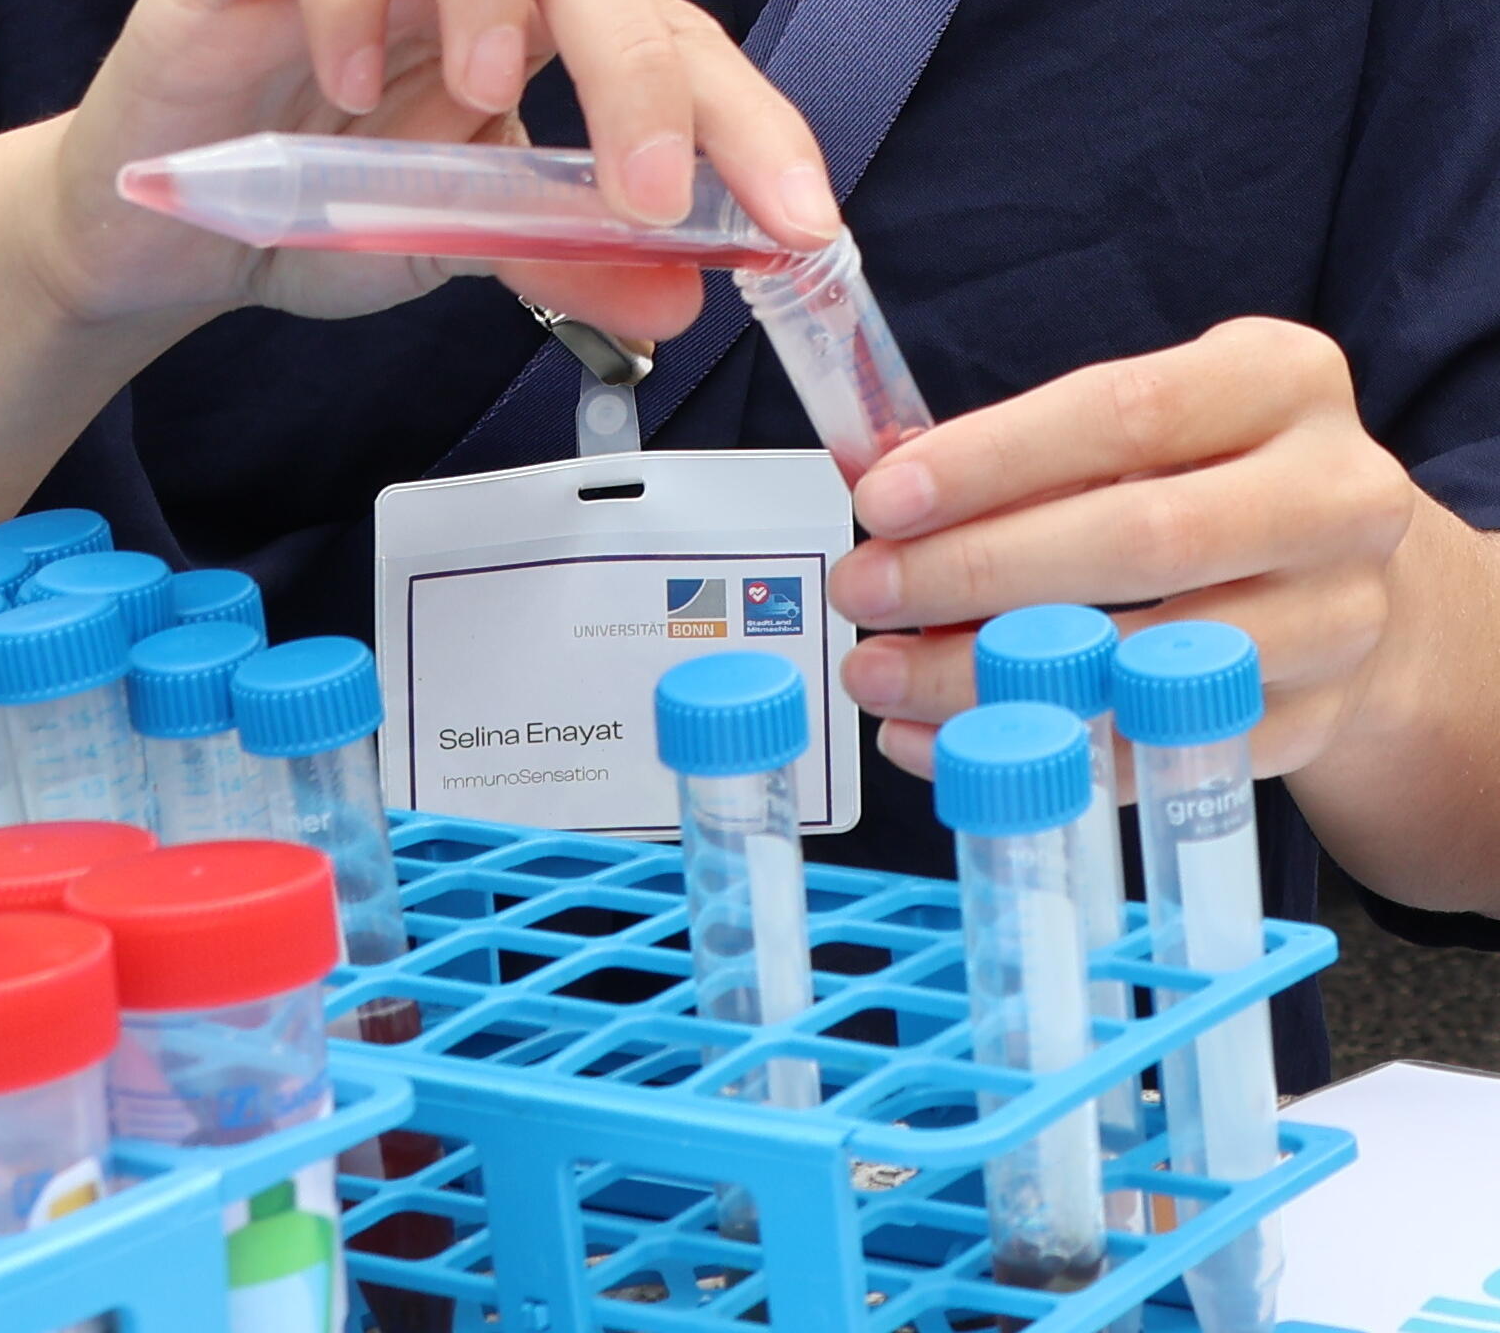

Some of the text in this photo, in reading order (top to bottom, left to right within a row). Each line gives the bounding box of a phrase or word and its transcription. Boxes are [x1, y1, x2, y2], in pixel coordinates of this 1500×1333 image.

[574, 621, 716, 639] UNIVERSITÄT BONN
[746, 618, 793, 627] StadtLand
[439, 719, 624, 751] Selina Enayat
[443, 765, 610, 790] ImmunoSensation
